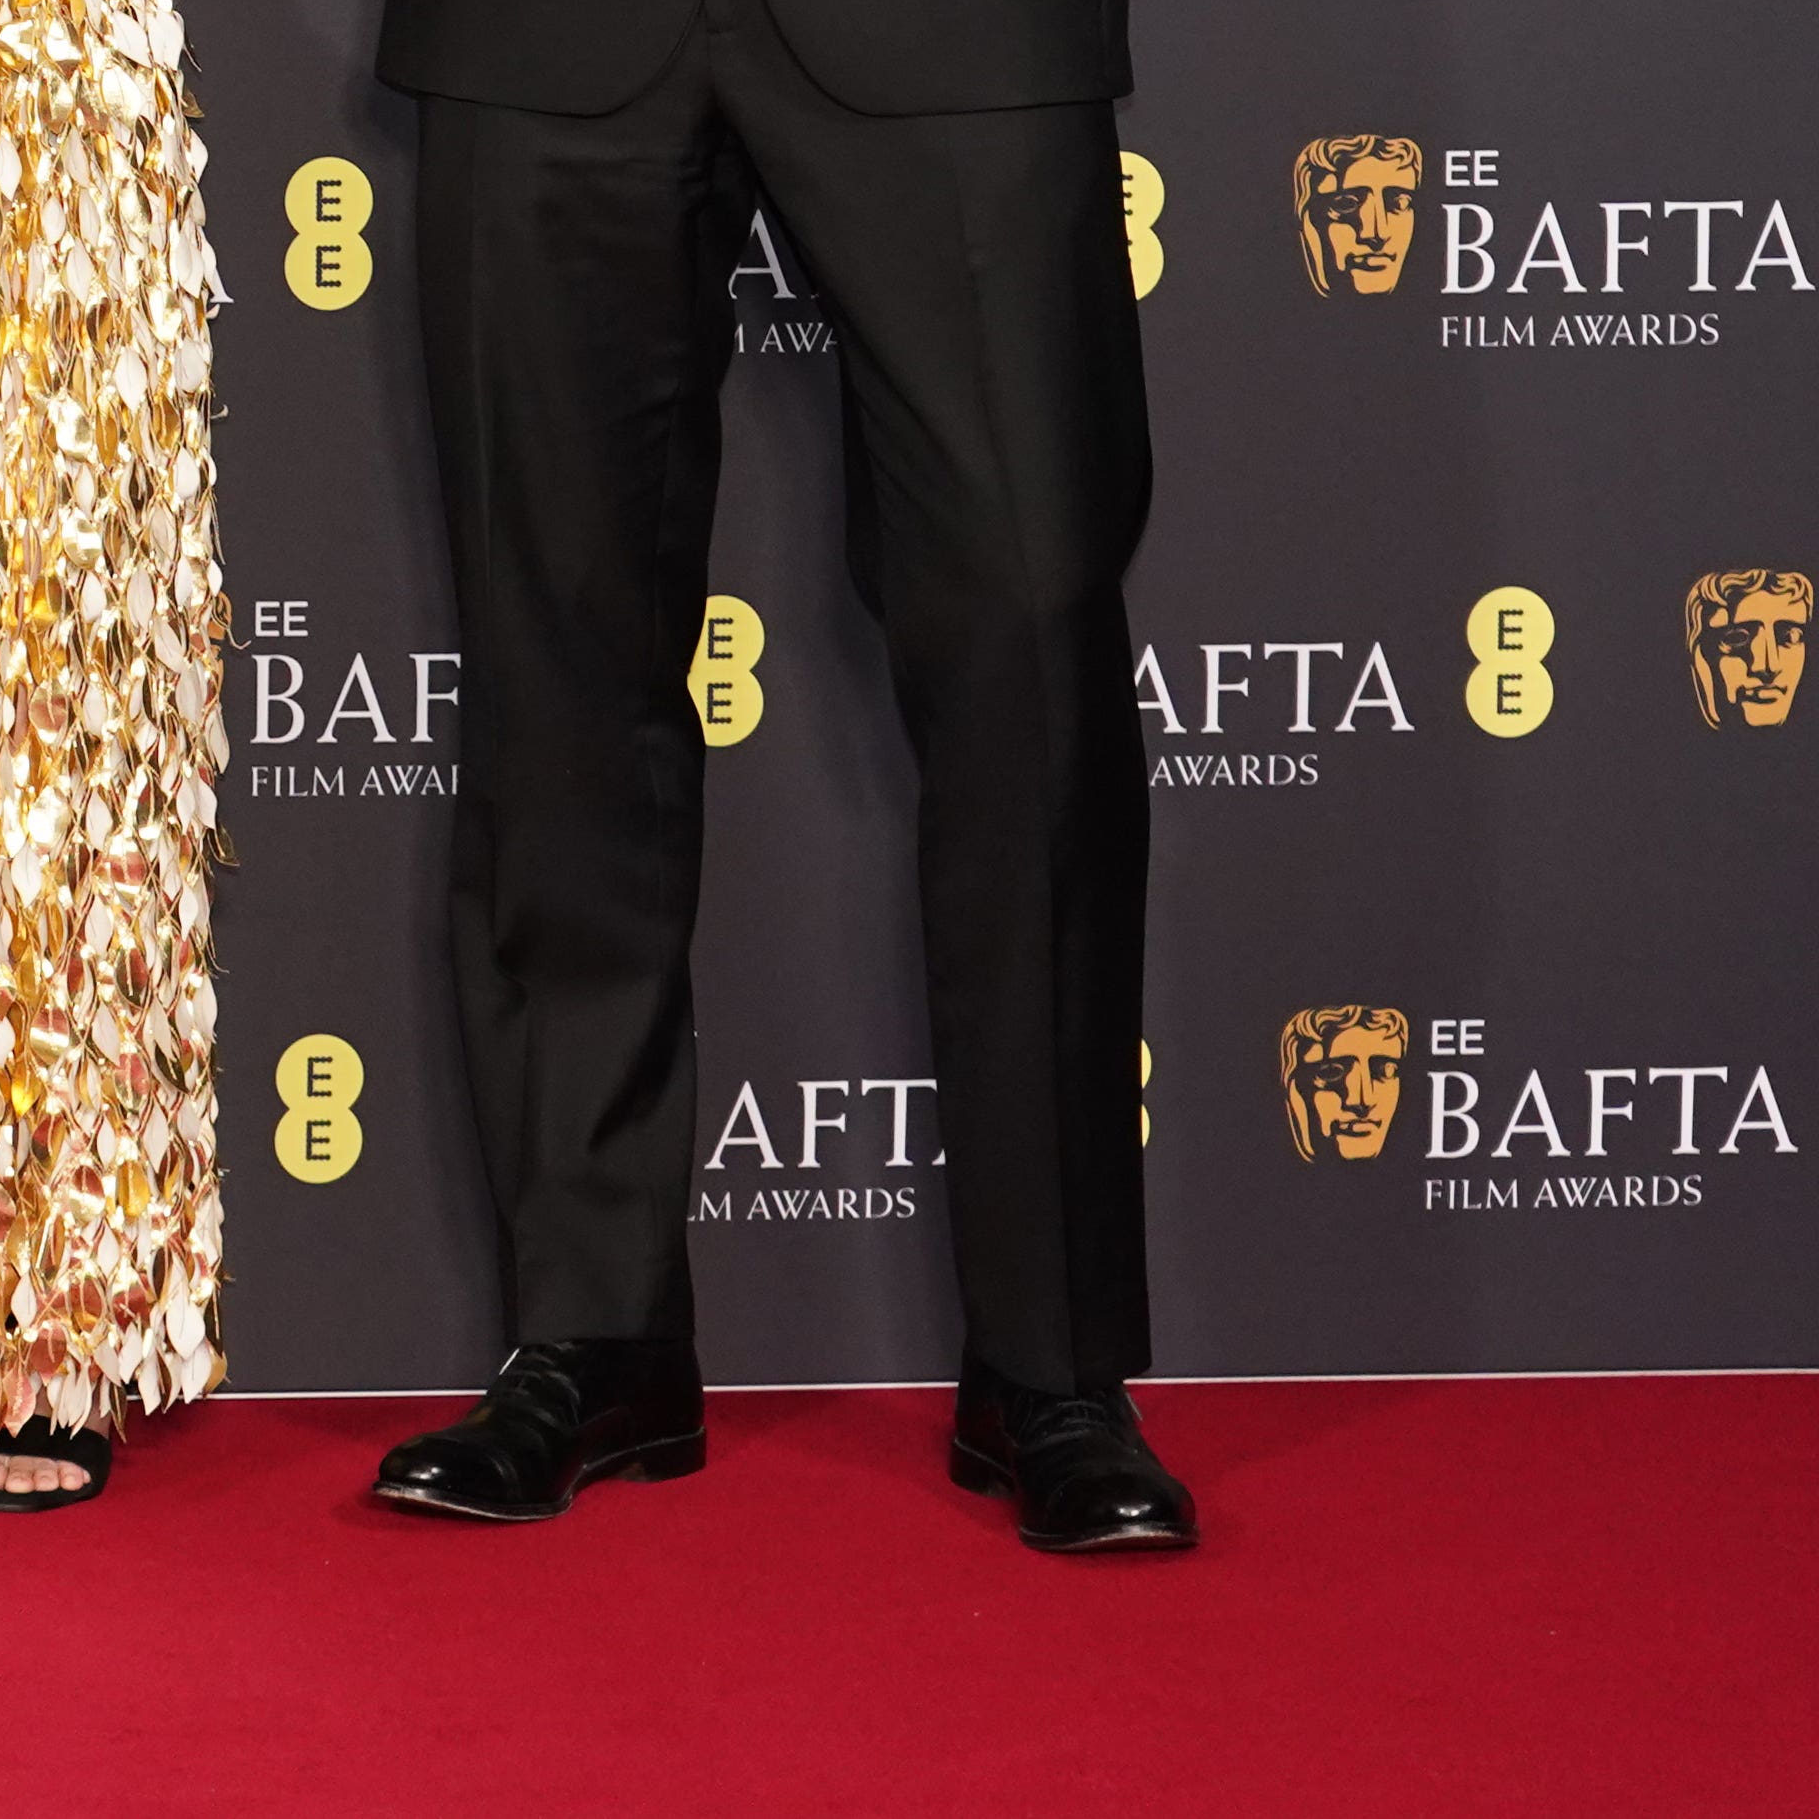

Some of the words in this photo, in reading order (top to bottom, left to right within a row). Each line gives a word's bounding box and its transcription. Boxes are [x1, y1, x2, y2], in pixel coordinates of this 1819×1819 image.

[1446, 150, 1499, 186] EE
[1441, 200, 1815, 293] BAFTA
[1442, 316, 1534, 347] FILM
[1551, 314, 1718, 346] AWARDS
[255, 601, 308, 636] EE
[252, 767, 344, 796] FILM
[1150, 754, 1318, 786] AWARDS
[1432, 1020, 1484, 1055] EE
[705, 1079, 945, 1169] AFT
[1426, 1066, 1798, 1158] BAFTA
[748, 1188, 914, 1219] AWARDS
[1427, 1180, 1517, 1209] FILM
[1534, 1174, 1703, 1207] AWARDS
